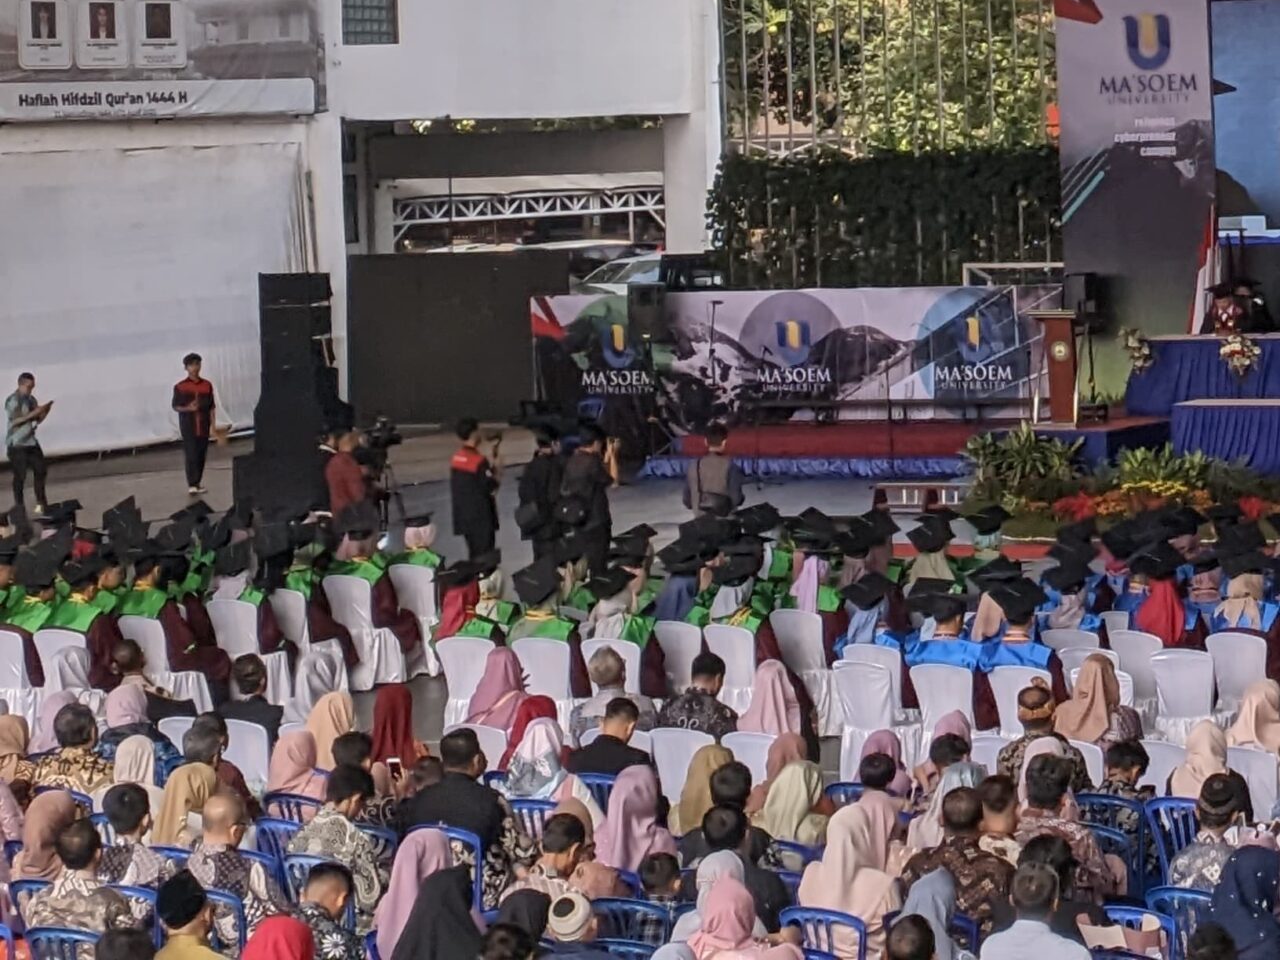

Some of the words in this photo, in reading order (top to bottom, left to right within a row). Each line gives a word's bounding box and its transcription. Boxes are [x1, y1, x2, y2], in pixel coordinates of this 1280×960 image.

[1099, 72, 1198, 95] MA'SOEM
[19, 93, 59, 107] Haflah
[61, 92, 102, 106] Hifdzil
[105, 91, 144, 107] Qur'an
[148, 91, 175, 104] 1444
[178, 91, 188, 104] H
[756, 368, 832, 383] MA'SOEM
[935, 365, 1012, 381] MA'SOEM
